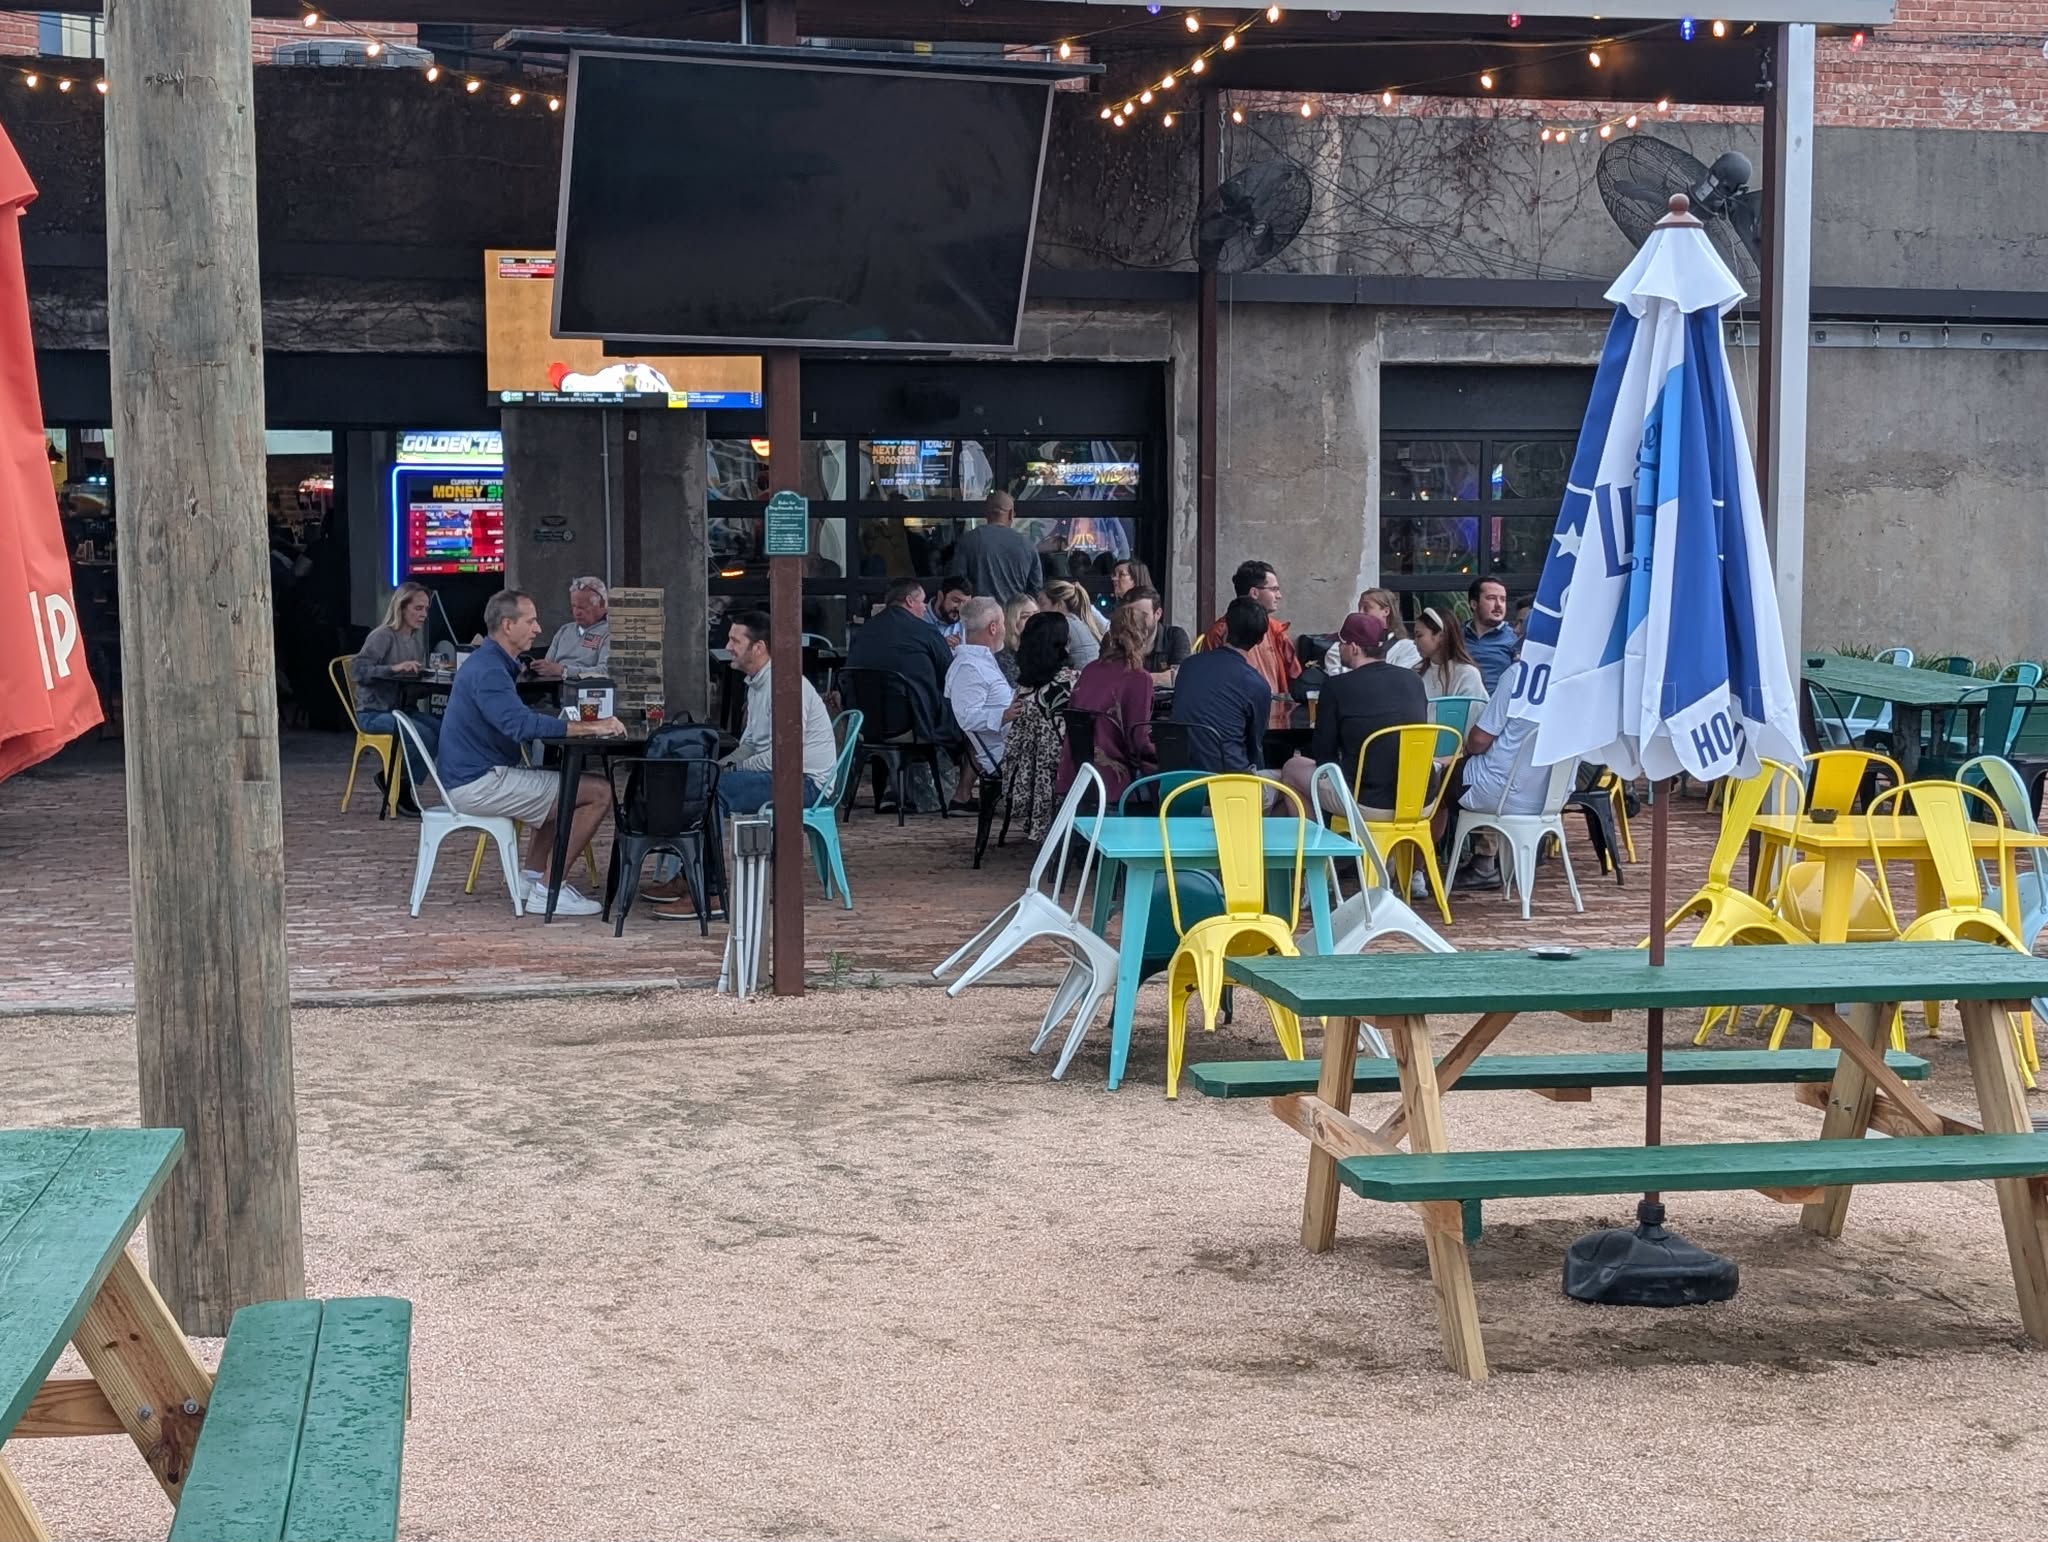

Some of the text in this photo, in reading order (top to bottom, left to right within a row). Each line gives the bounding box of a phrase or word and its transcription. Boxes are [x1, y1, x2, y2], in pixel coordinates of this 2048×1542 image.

[402, 435, 472, 453] GOLDEN
[872, 445, 897, 455] NEXT
[433, 485, 483, 498] MONEY
[28, 589, 79, 690] IP
